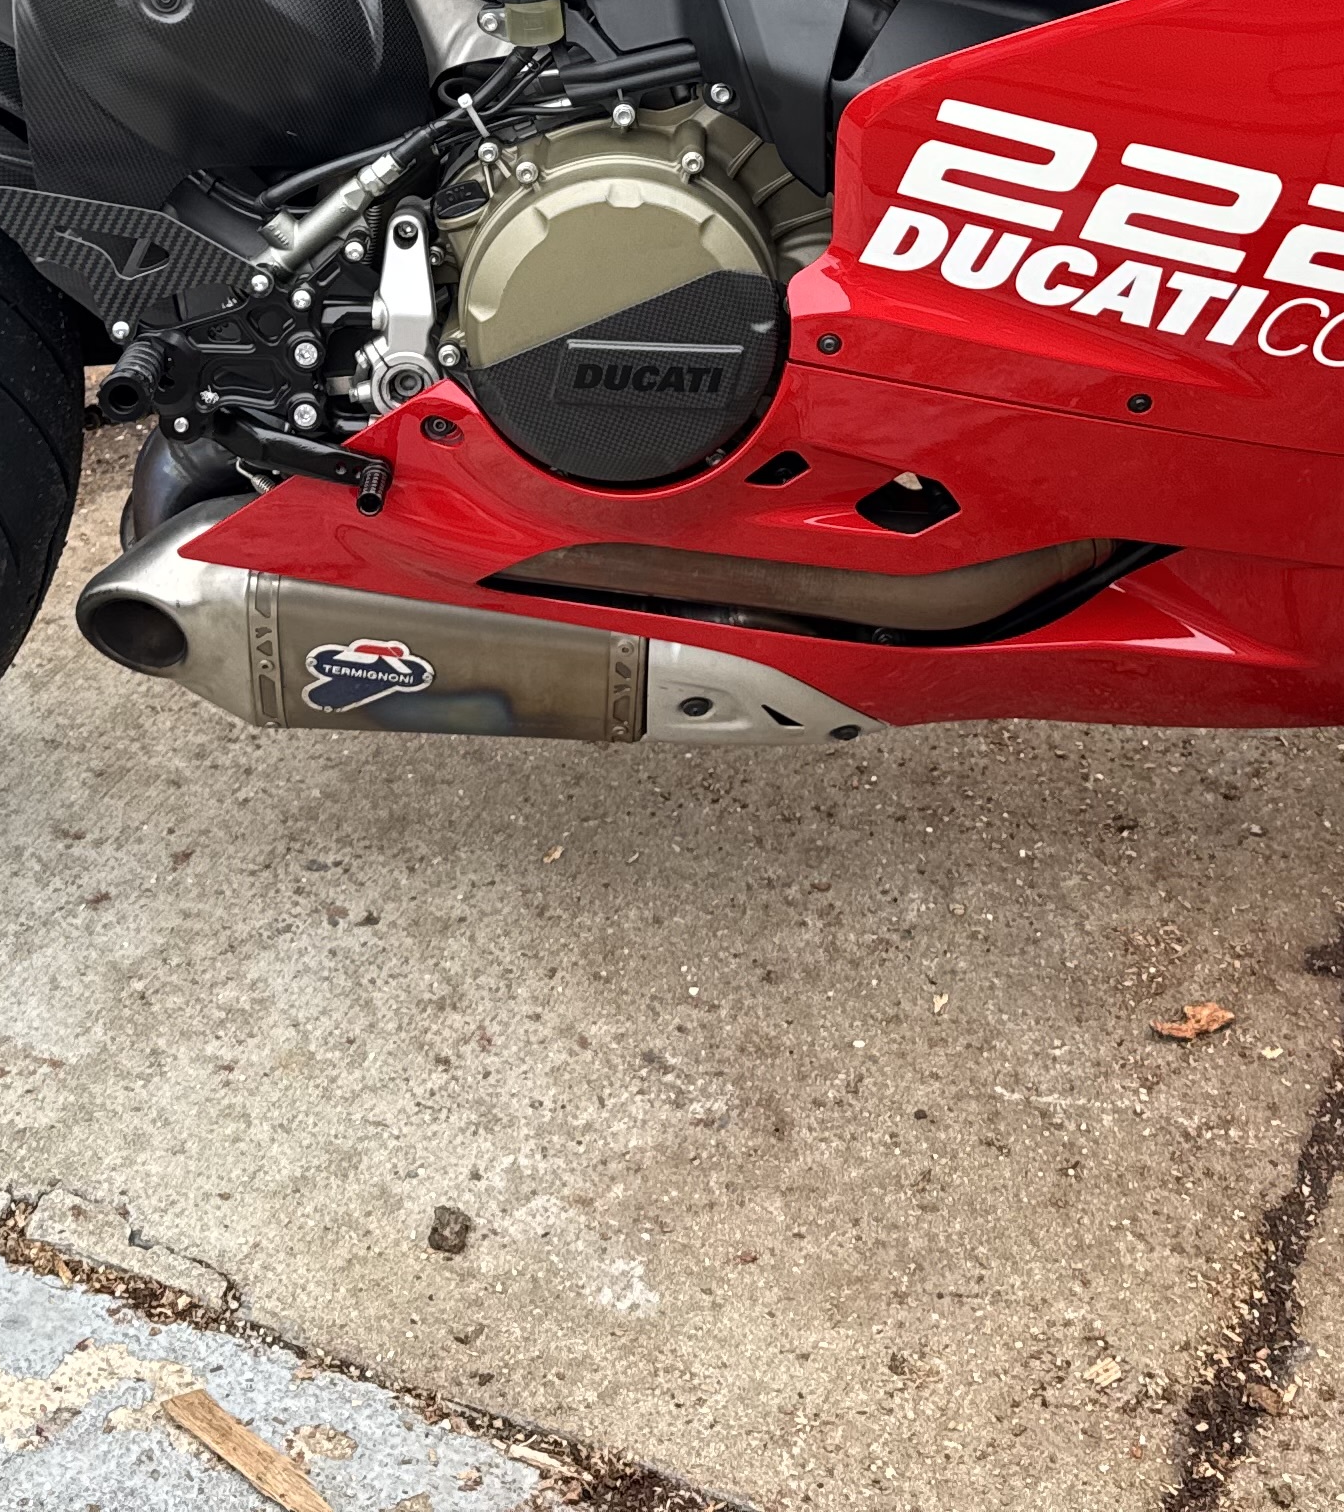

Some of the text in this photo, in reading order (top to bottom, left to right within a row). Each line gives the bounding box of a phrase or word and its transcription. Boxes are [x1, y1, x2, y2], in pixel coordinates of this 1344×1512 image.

[858, 205, 1270, 347] DUCATI
[573, 364, 724, 393] DUCATI
[323, 664, 414, 684] TERMIGNONI
